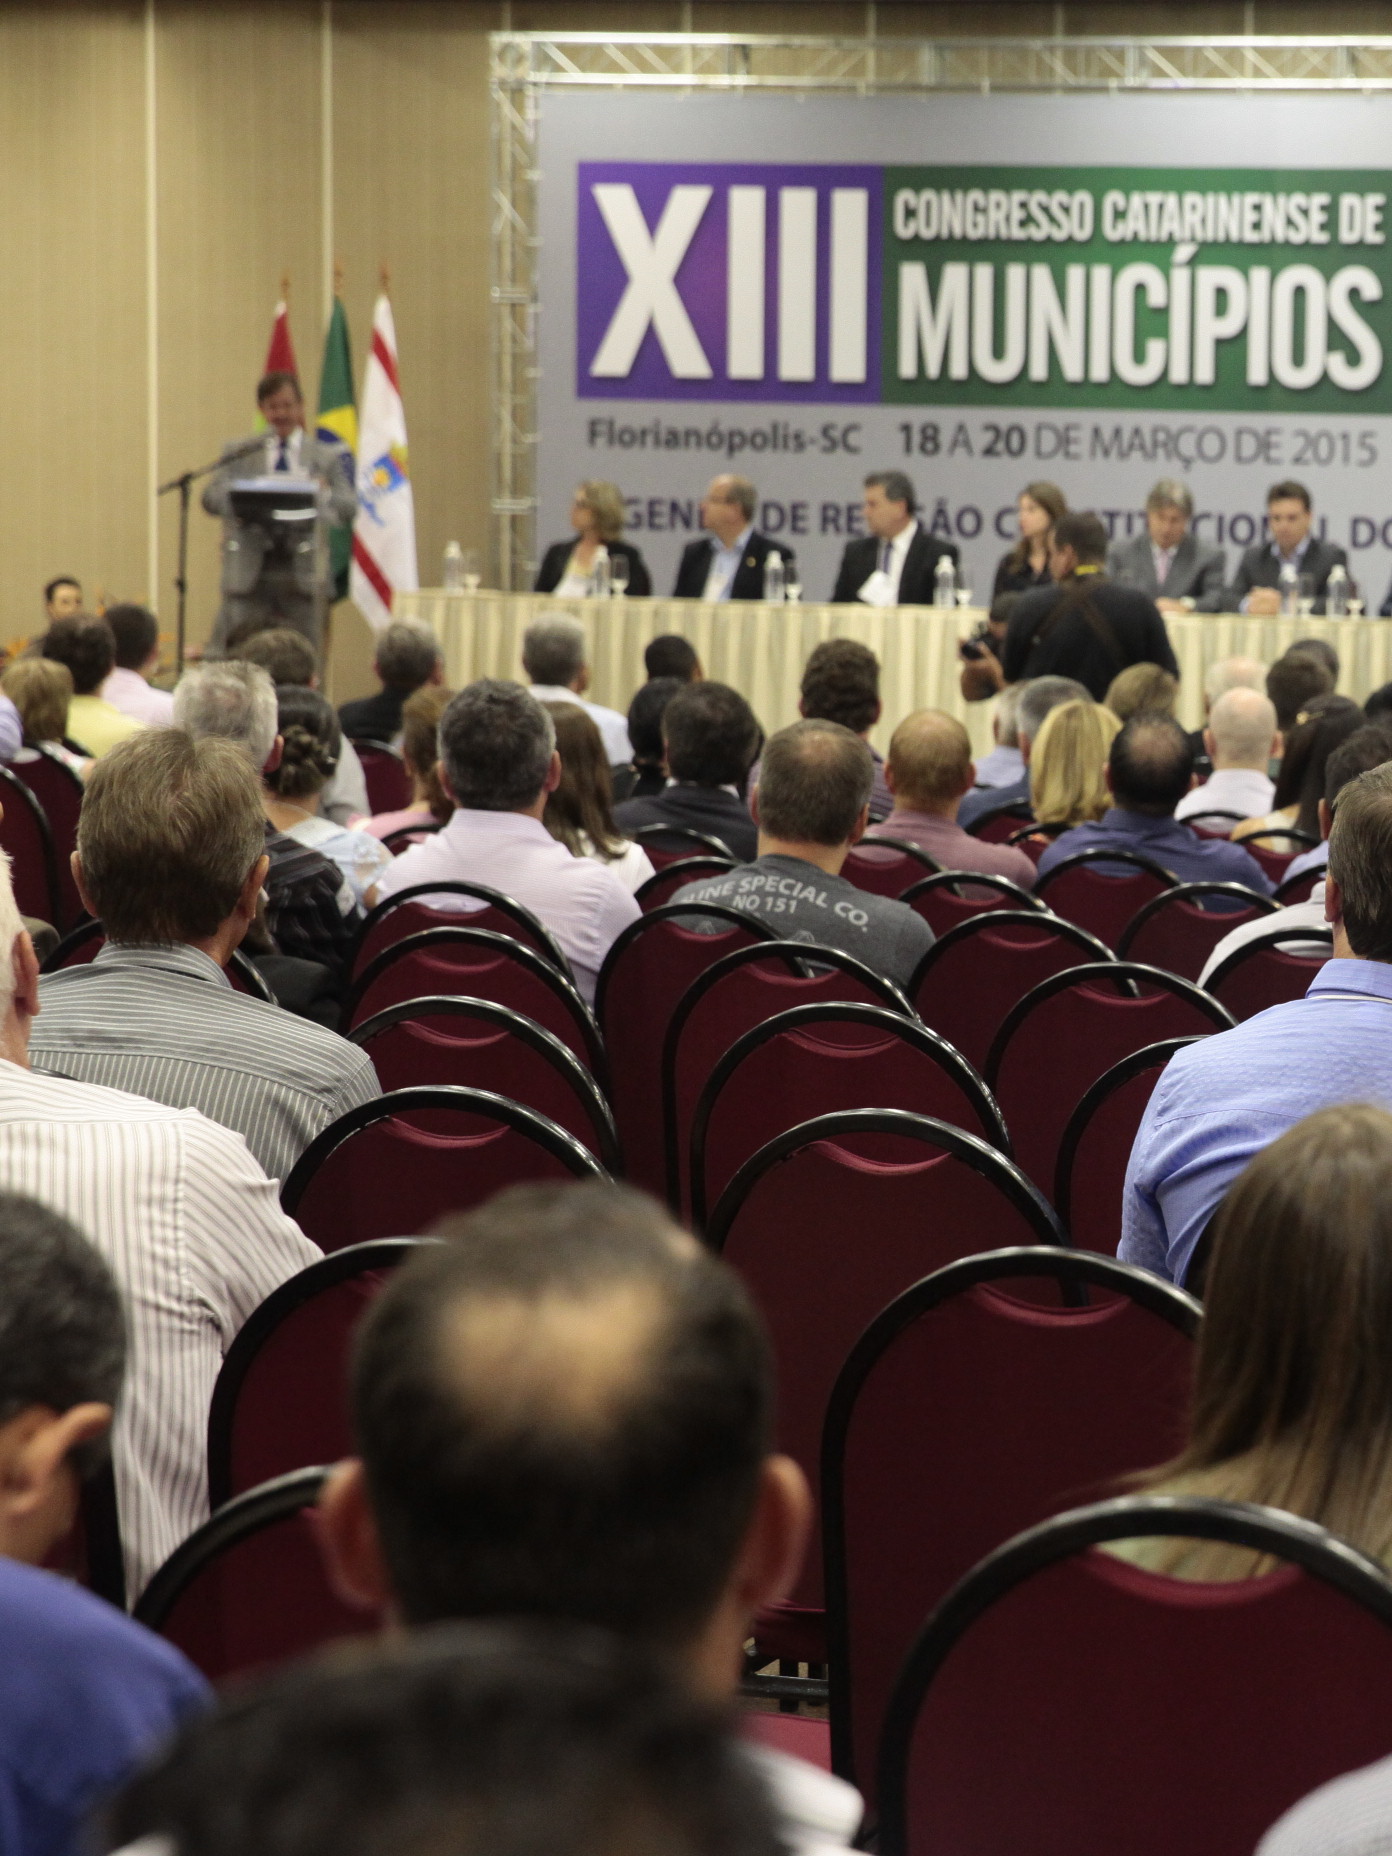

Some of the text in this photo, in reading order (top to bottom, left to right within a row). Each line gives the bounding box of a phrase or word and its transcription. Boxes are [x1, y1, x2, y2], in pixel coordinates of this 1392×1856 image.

[894, 189, 1387, 244] CONGRESSO CATARINENSE DE
[589, 183, 869, 384] XIII
[897, 243, 1383, 391] MUNICÍPIOS
[587, 416, 863, 457] Florianópolis-SC
[900, 424, 1378, 471] 18 A 20 DE MARÇO DE 2015
[761, 501, 810, 535] DE
[732, 895, 798, 914] NO 151
[737, 875, 829, 908] SPECIAL
[833, 901, 869, 933] CO.
